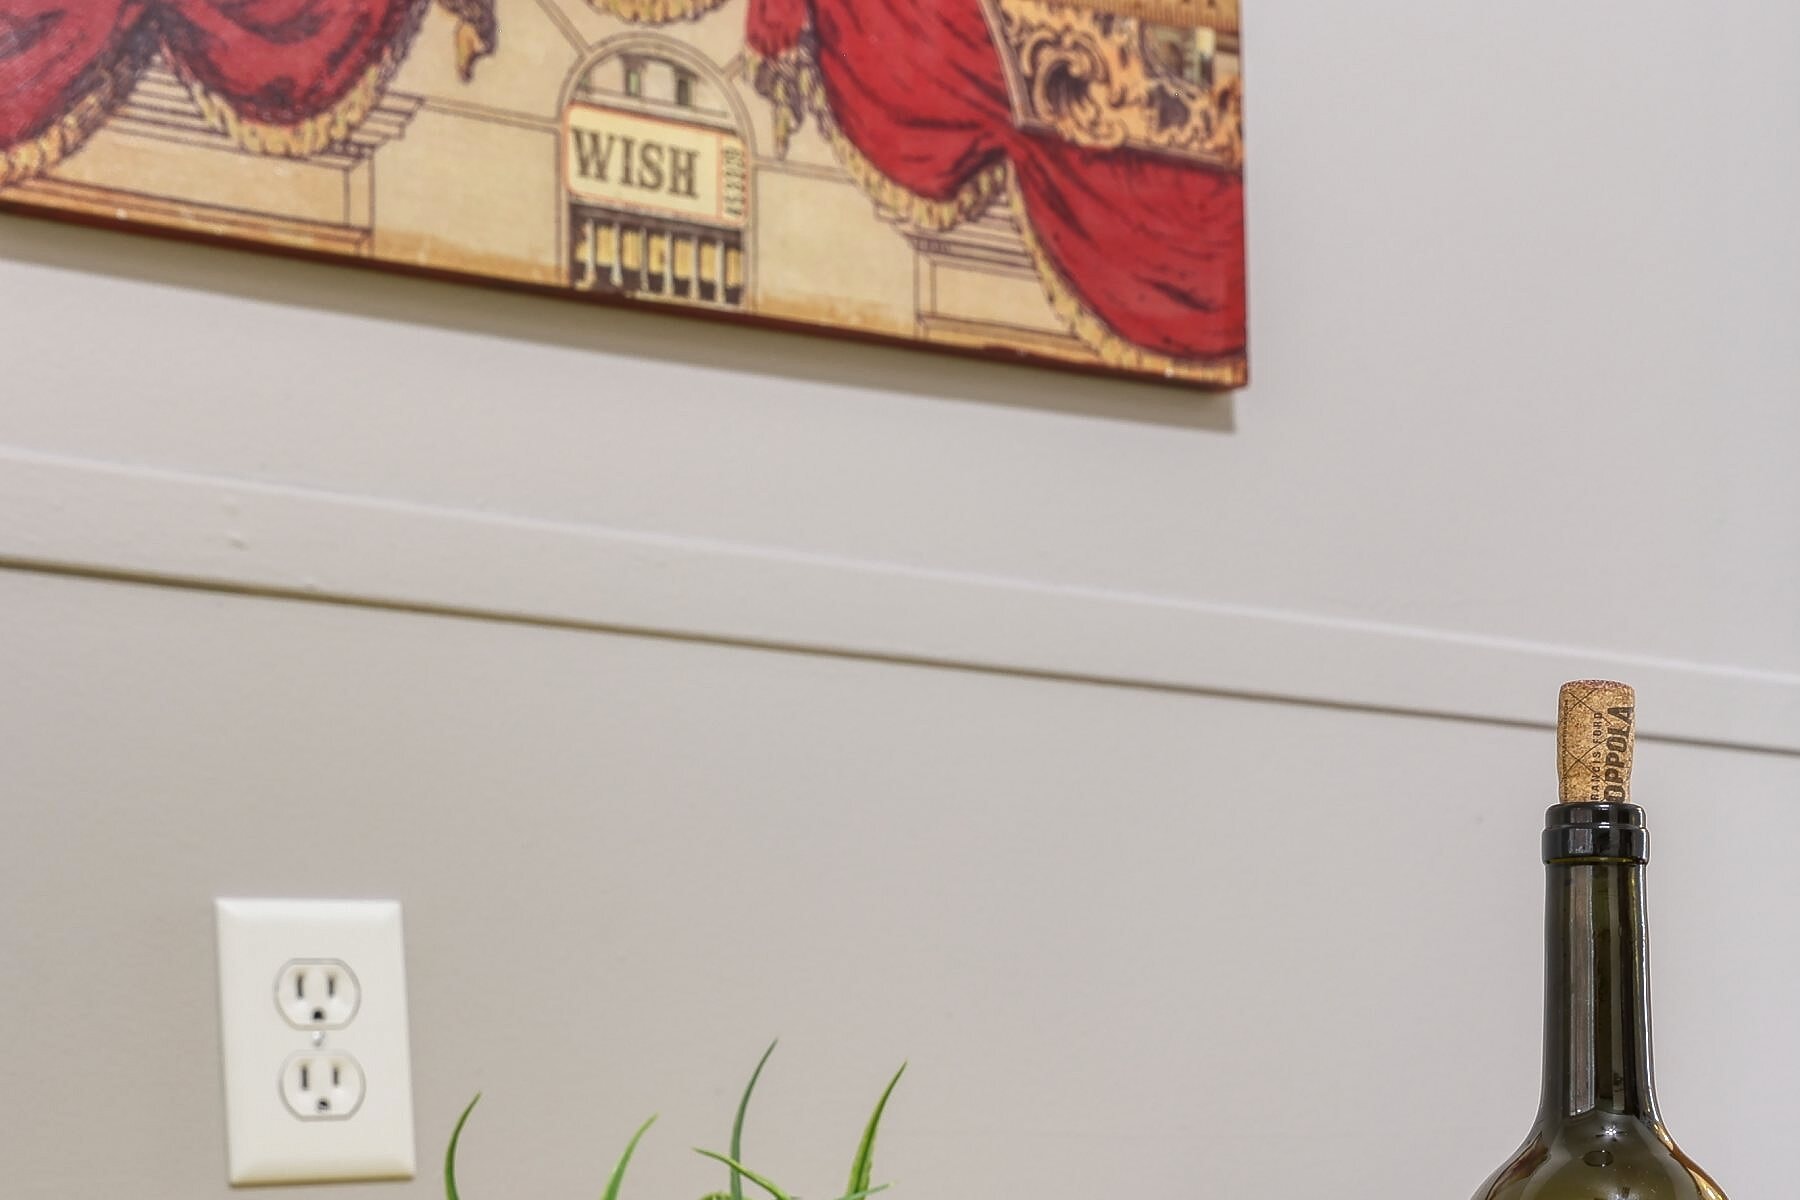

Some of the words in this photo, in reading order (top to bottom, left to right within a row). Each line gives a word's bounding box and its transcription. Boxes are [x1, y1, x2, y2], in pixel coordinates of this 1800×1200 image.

[571, 128, 700, 198] WISH
[1593, 712, 1603, 744] FORD
[1603, 707, 1634, 802] OPPOLA
[1590, 751, 1602, 801] RANCIS
